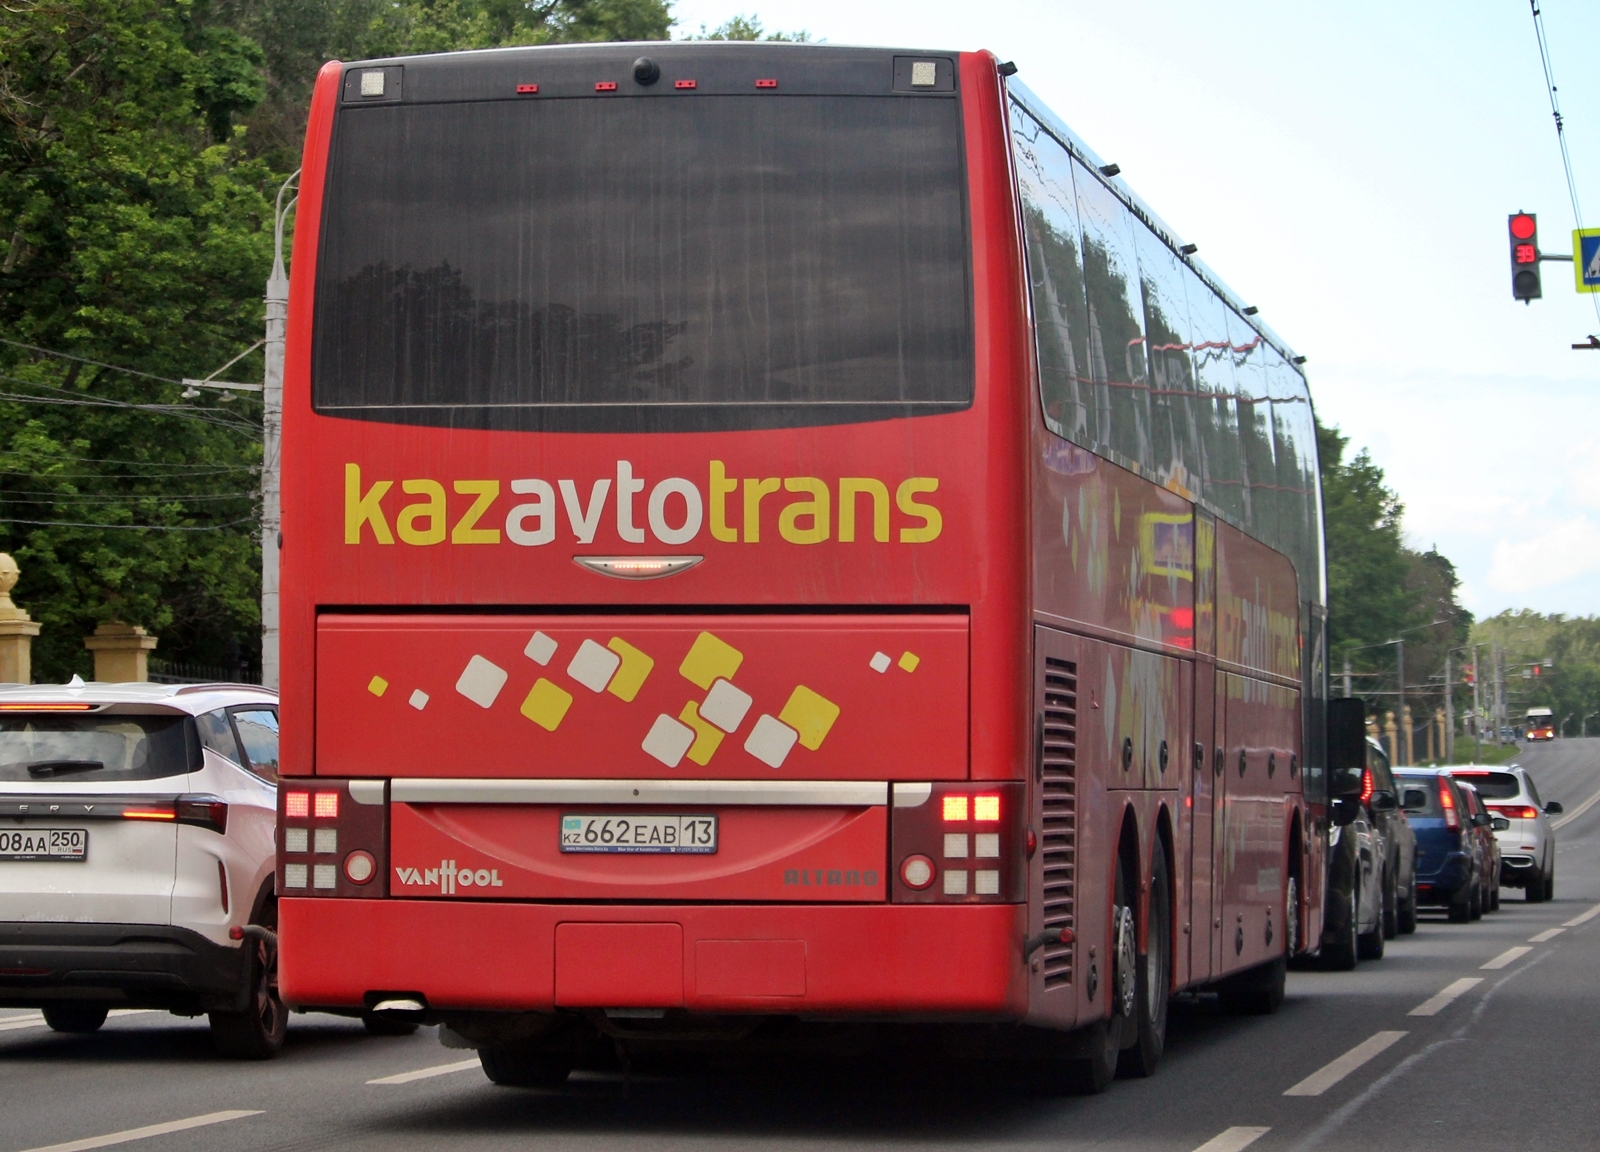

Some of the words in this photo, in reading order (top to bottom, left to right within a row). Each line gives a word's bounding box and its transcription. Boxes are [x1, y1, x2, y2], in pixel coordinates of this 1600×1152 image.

[1516, 245, 1535, 263] 39
[345, 460, 943, 546] kazavtotrans
[0, 833, 46, 852] 08AA
[51, 832, 80, 847] 250
[563, 833, 581, 844] KZ
[684, 820, 712, 844] 13
